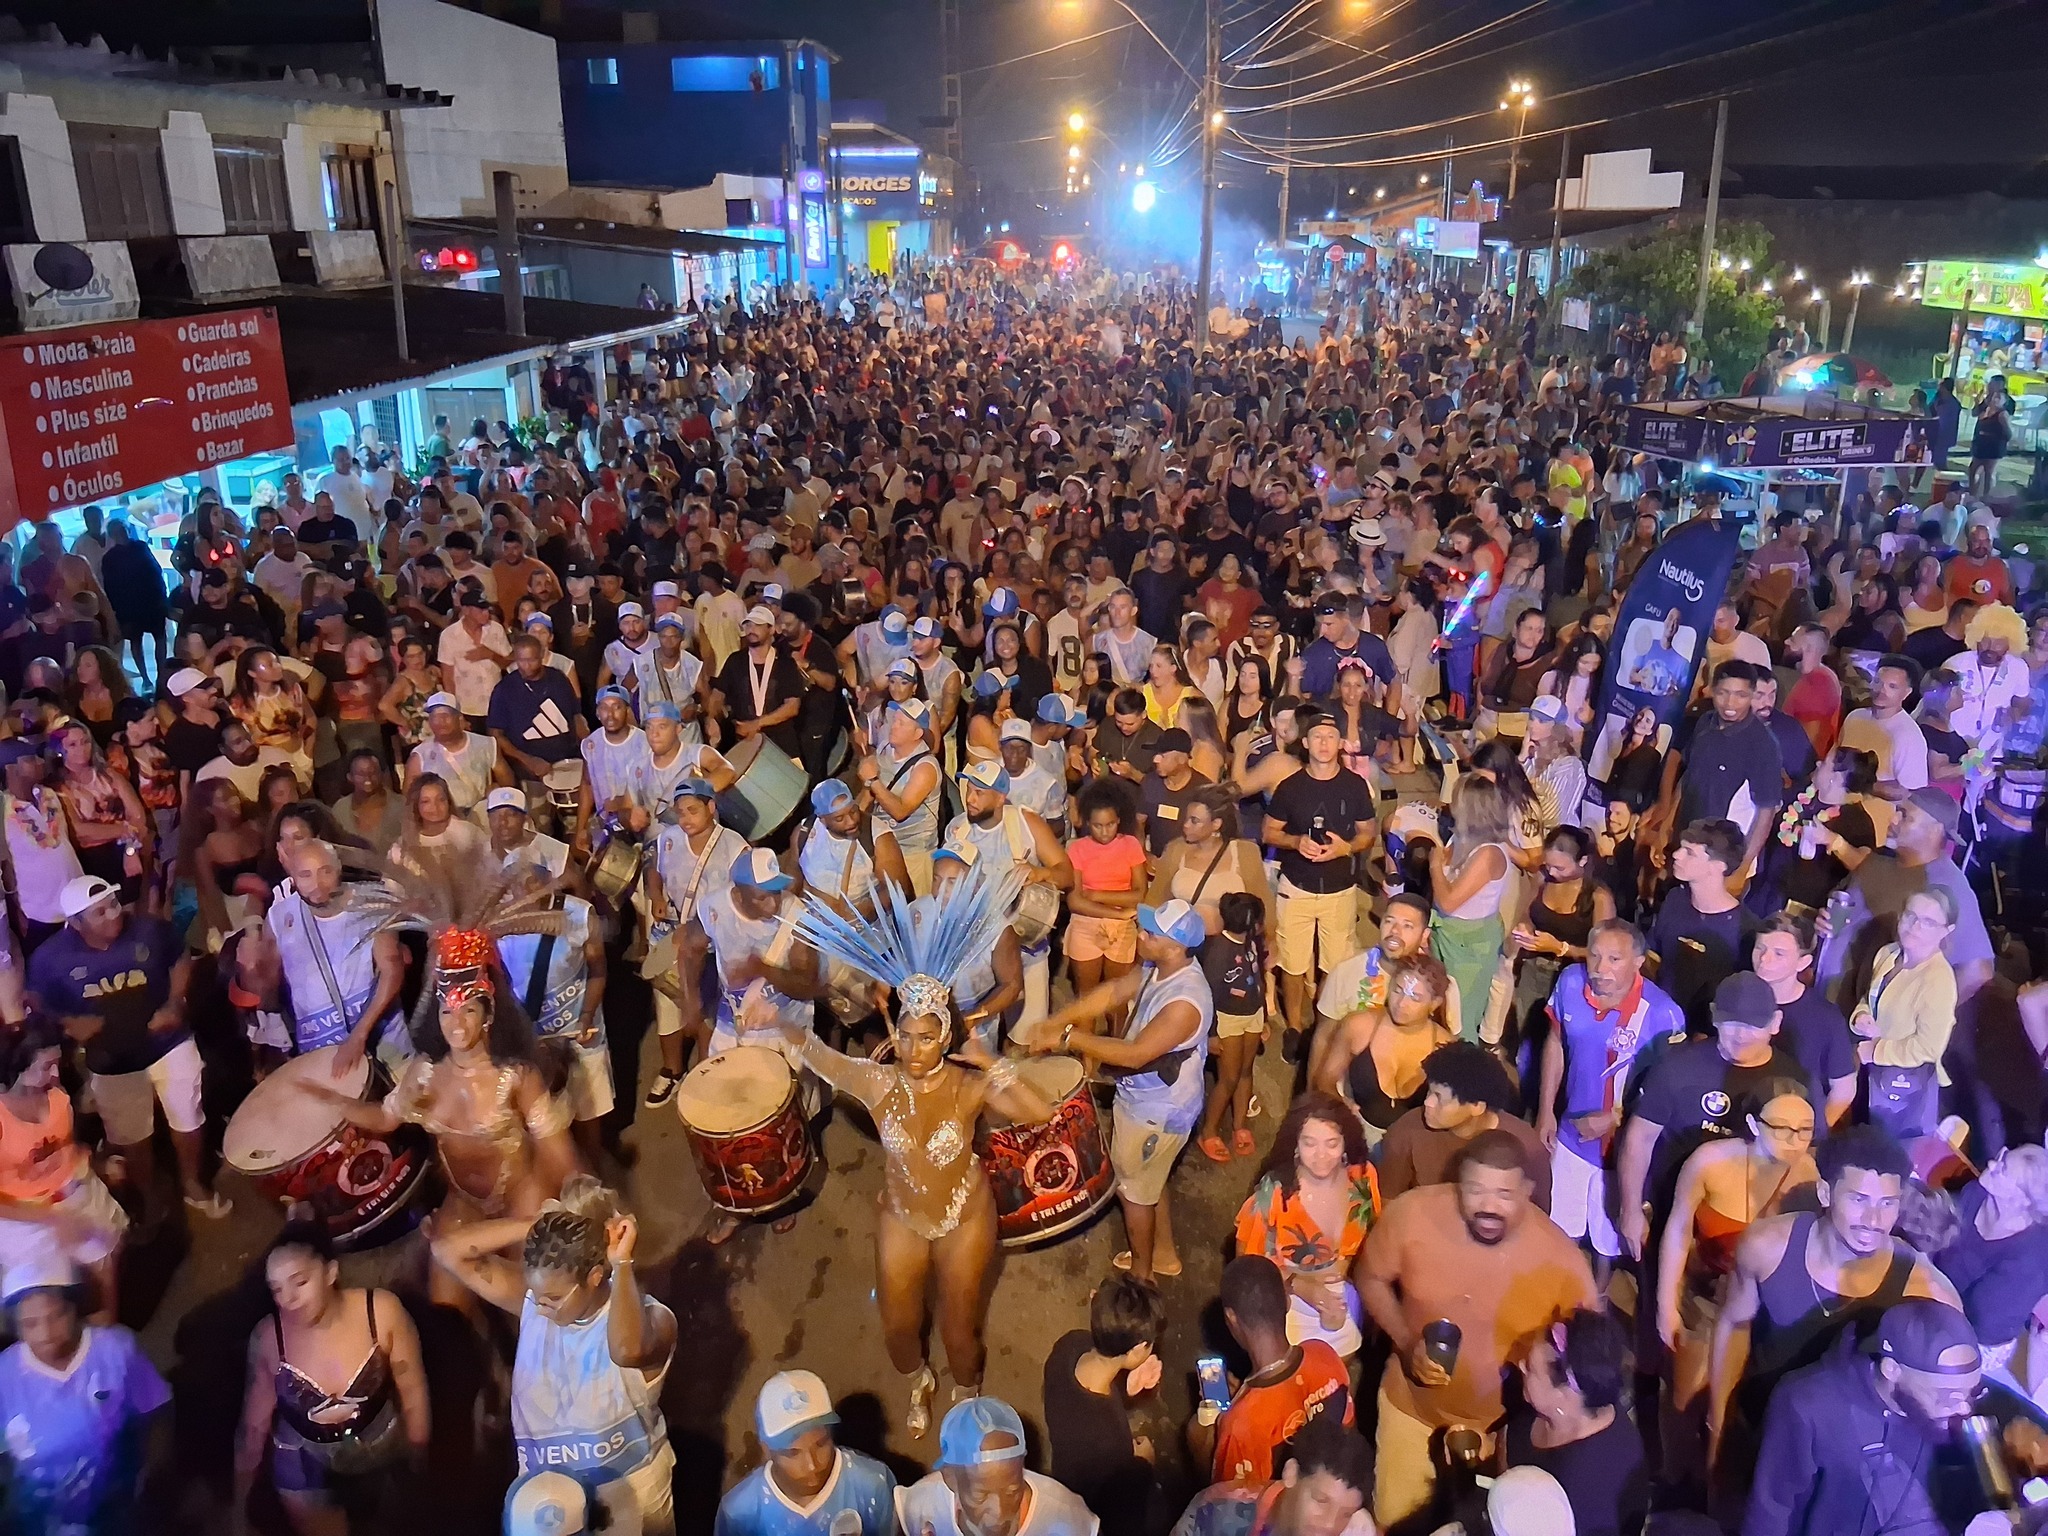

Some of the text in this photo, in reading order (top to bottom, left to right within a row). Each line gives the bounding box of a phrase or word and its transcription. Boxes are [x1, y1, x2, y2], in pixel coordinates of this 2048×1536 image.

[188, 314, 260, 343] Guarda sol
[38, 331, 135, 366] Moda Praia
[192, 348, 252, 374] Cadeiras
[44, 367, 133, 401] Masculina
[196, 374, 259, 403] Pranchas
[50, 400, 127, 434] Plus size
[201, 400, 274, 433] Brinquedos
[1644, 421, 1678, 440] ELITE
[56, 432, 119, 469] Infantil
[205, 438, 245, 462] Bazar
[1791, 428, 1855, 453] ELITE
[63, 470, 123, 502] Óculos
[1659, 558, 1705, 602] Nautilus
[541, 978, 583, 1012] ENTOS
[533, 1431, 625, 1465] VENTOS
